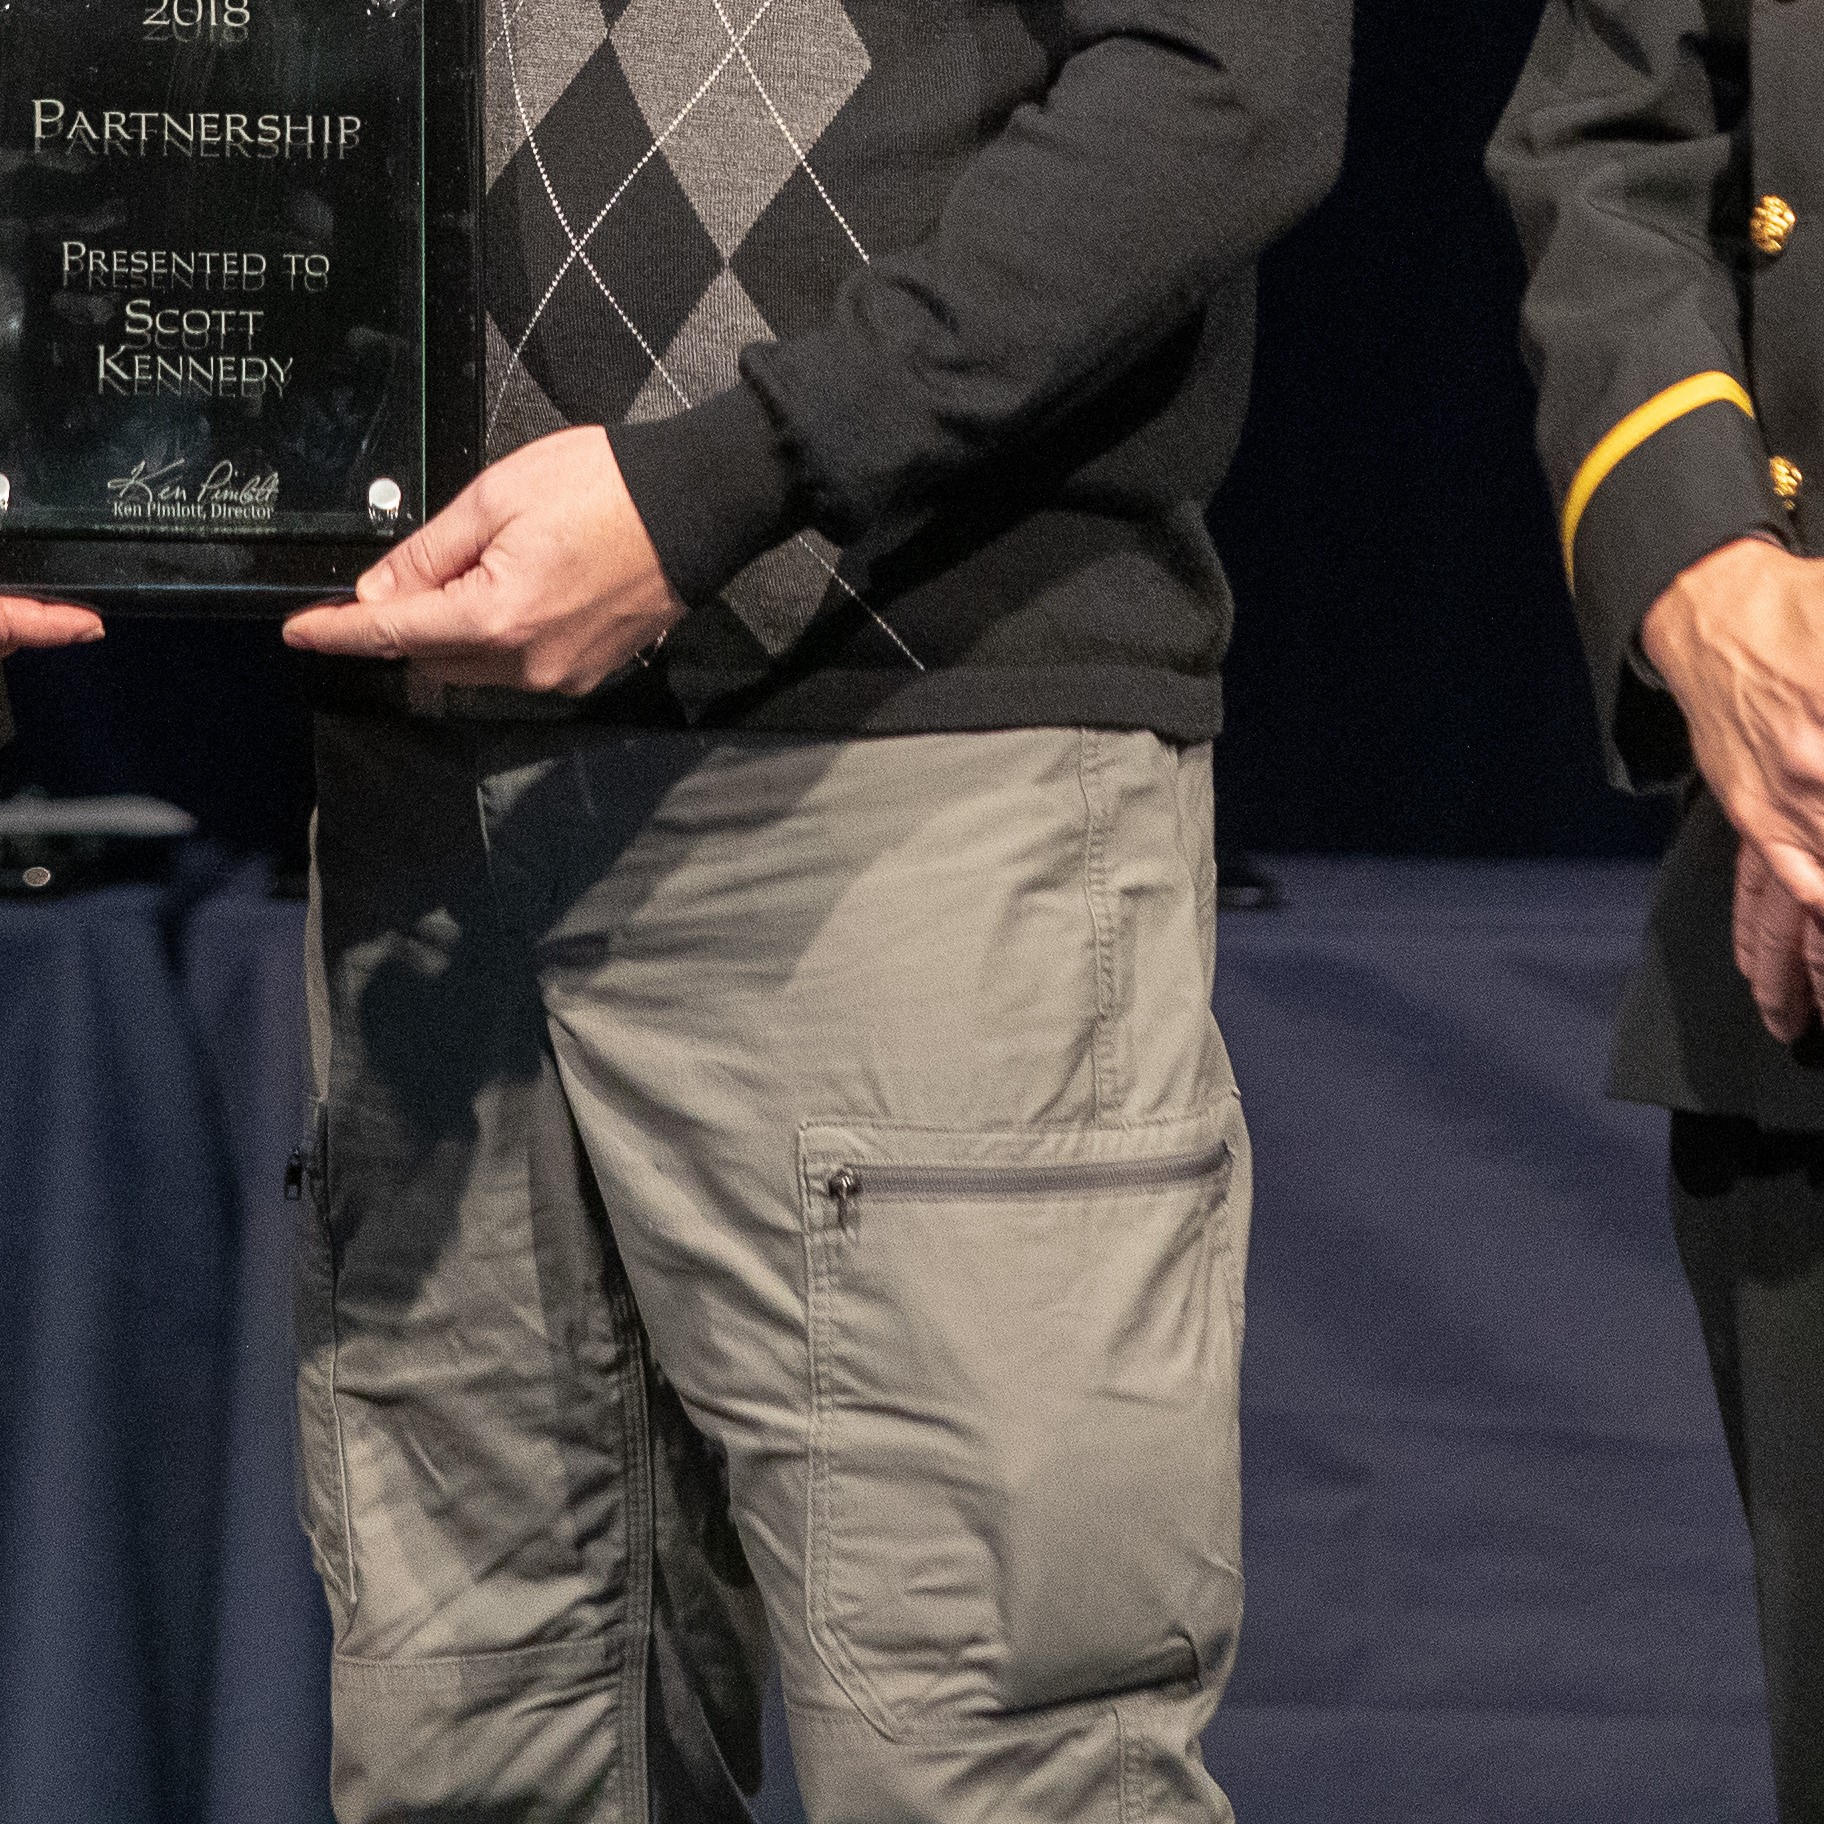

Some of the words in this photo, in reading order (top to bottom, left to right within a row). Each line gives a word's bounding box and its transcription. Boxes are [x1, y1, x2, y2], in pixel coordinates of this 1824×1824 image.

[31, 98, 361, 145] PARTNERSHIP
[62, 241, 266, 277] PRESENTED
[284, 253, 330, 277] TO
[124, 300, 264, 336] SCOTT
[97, 344, 293, 383] KENNEDY
[113, 502, 142, 517] Ken
[211, 503, 274, 518] Director
